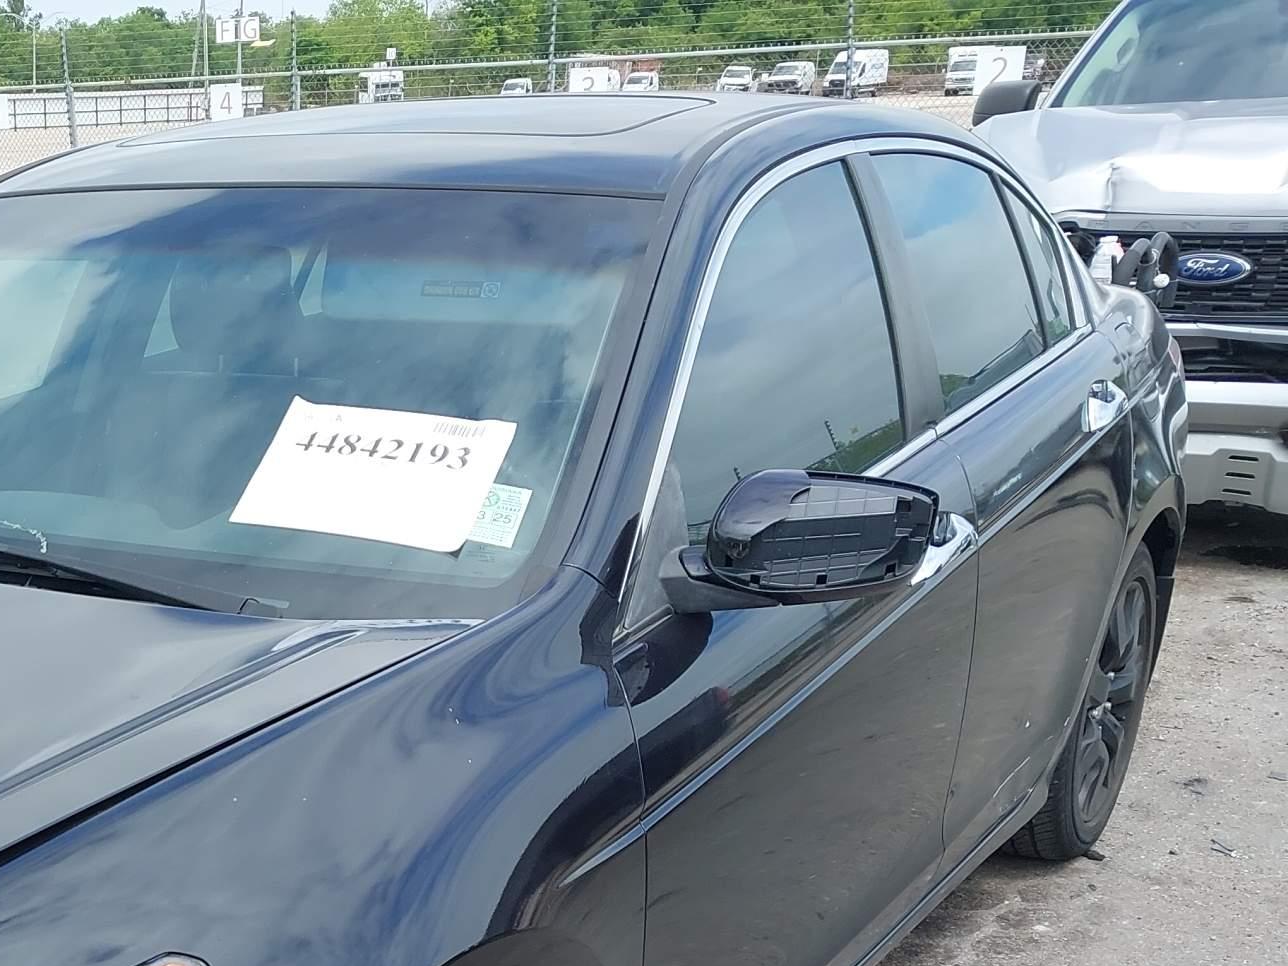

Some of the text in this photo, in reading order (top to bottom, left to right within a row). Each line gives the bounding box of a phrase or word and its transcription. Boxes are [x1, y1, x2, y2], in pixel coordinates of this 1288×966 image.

[219, 91, 232, 114] 4
[1182, 257, 1231, 278] Ford
[295, 430, 471, 470] 44842193
